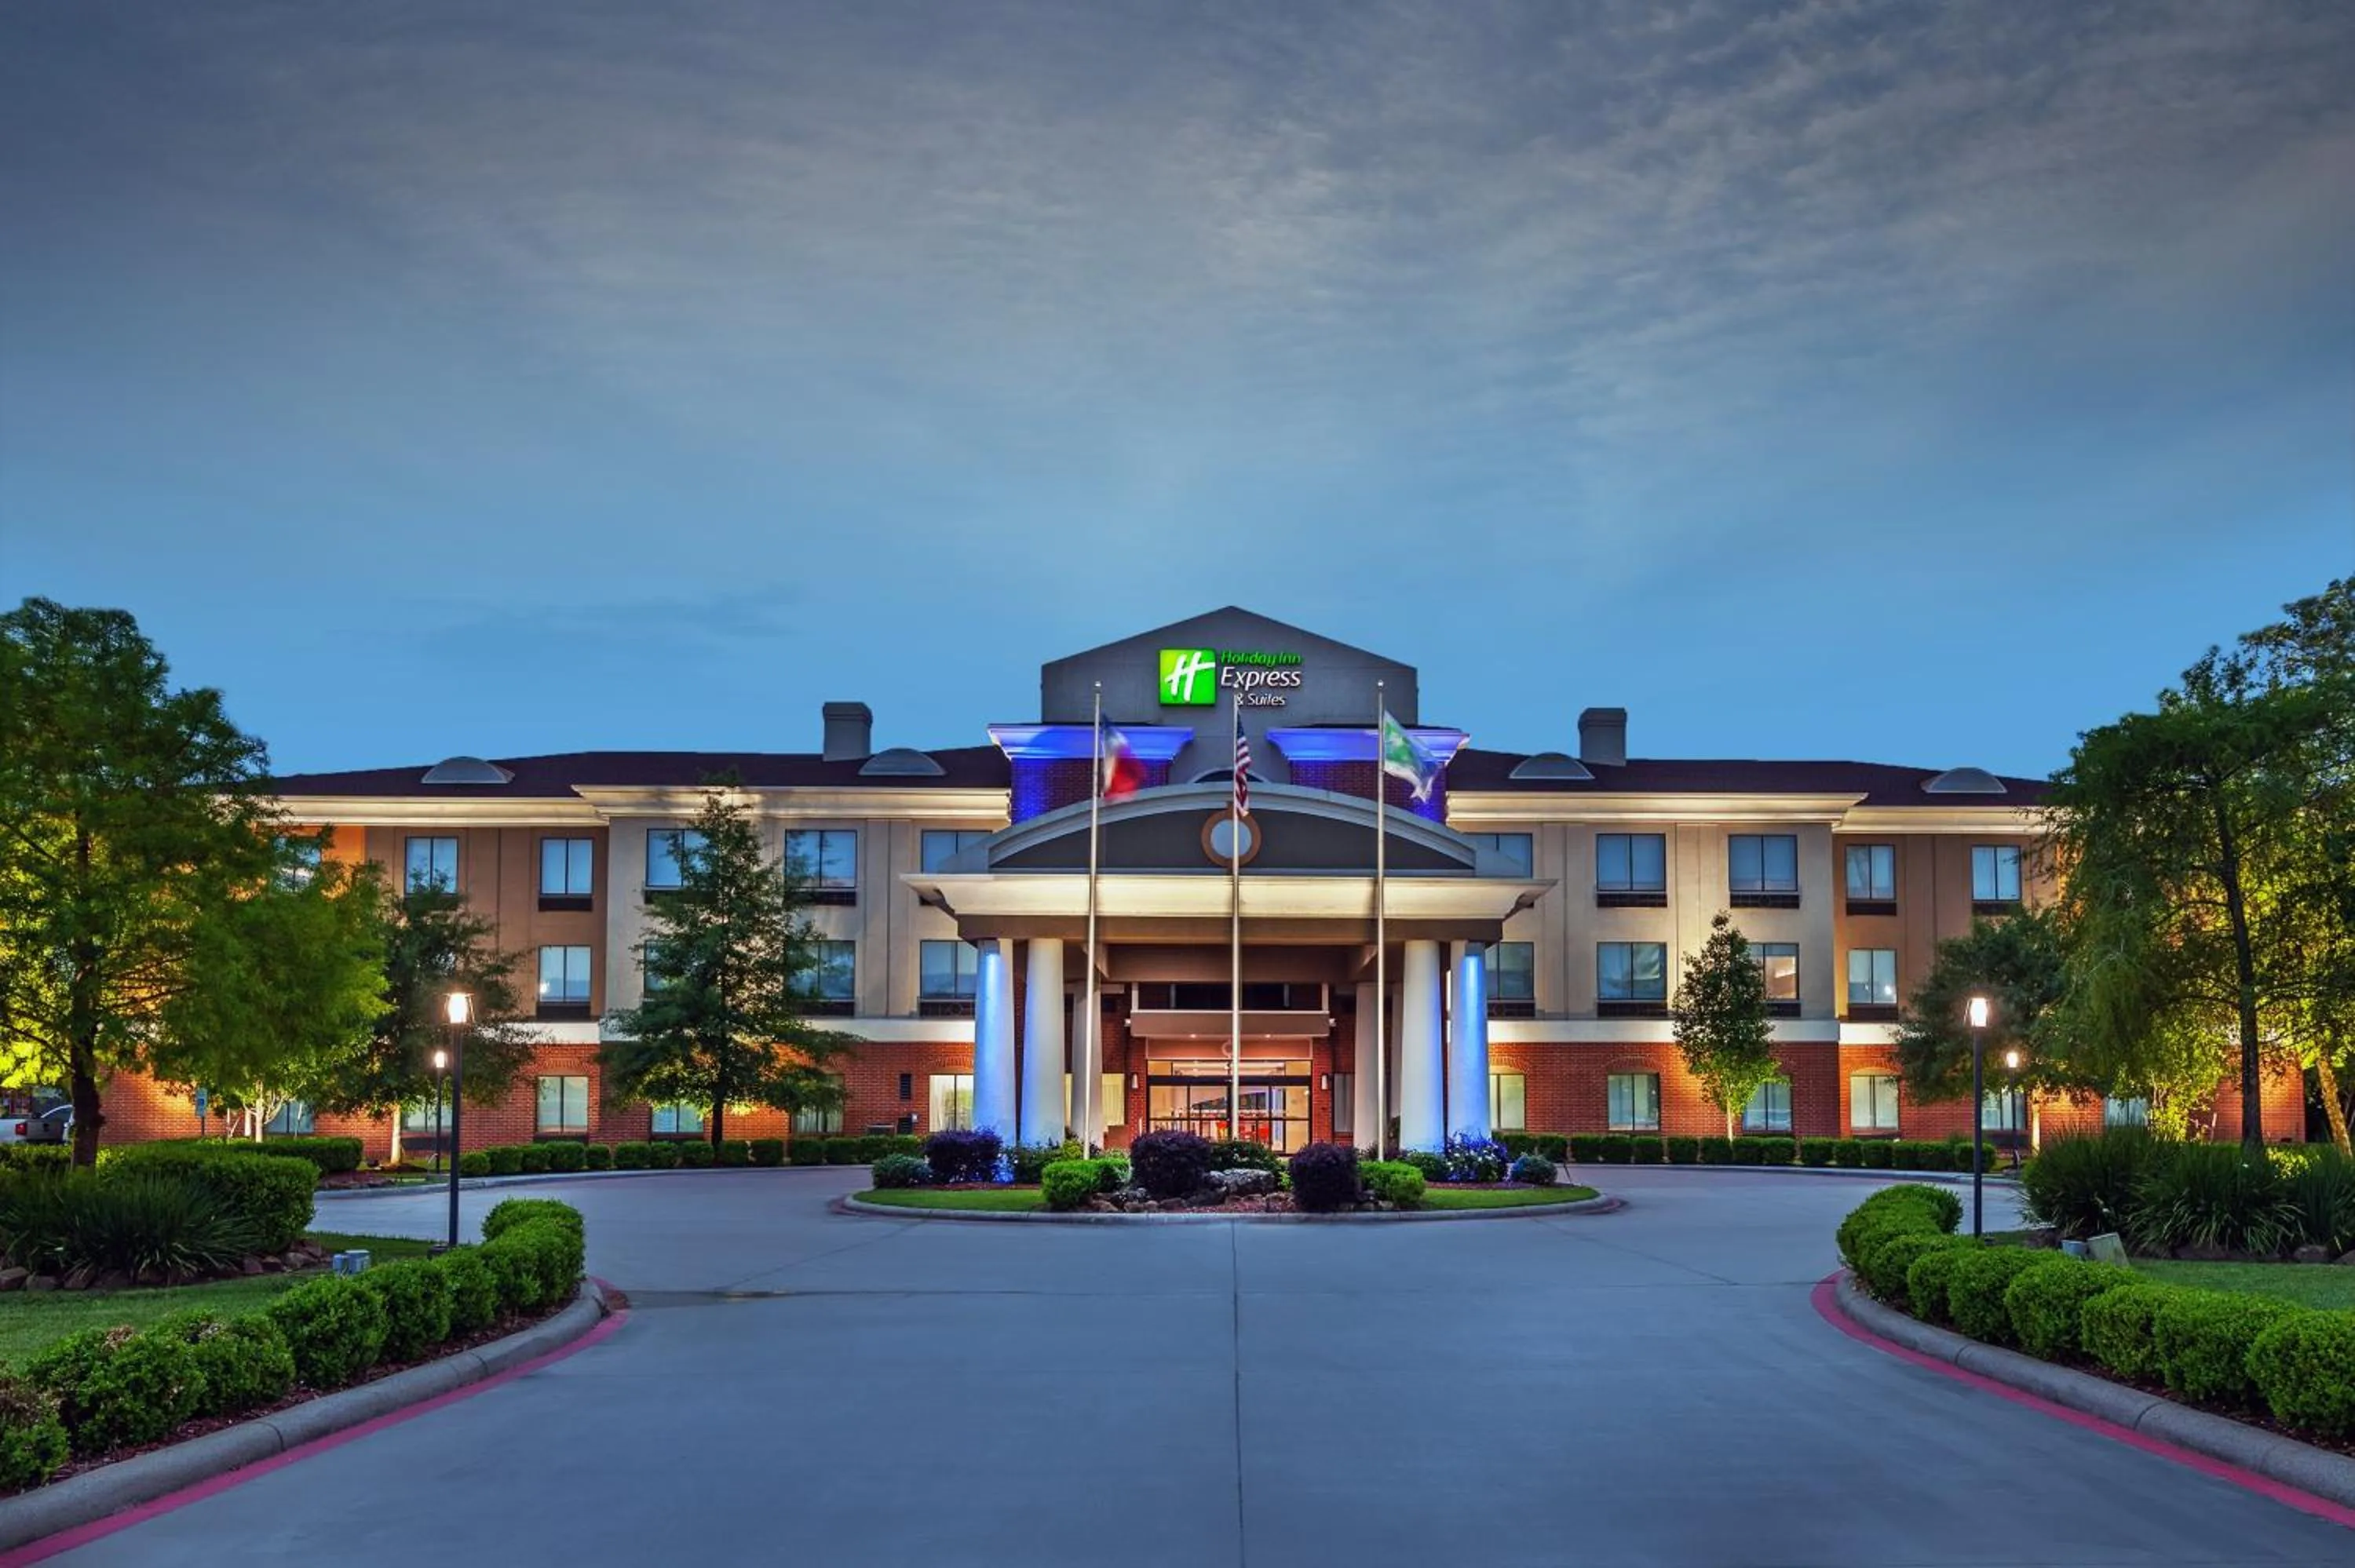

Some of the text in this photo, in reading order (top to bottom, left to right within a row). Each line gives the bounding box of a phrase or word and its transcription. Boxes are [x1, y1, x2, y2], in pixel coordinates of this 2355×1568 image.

[1221, 650, 1302, 667] Holiday Inn
[1221, 666, 1302, 691] Express
[1247, 693, 1286, 706] Suites
